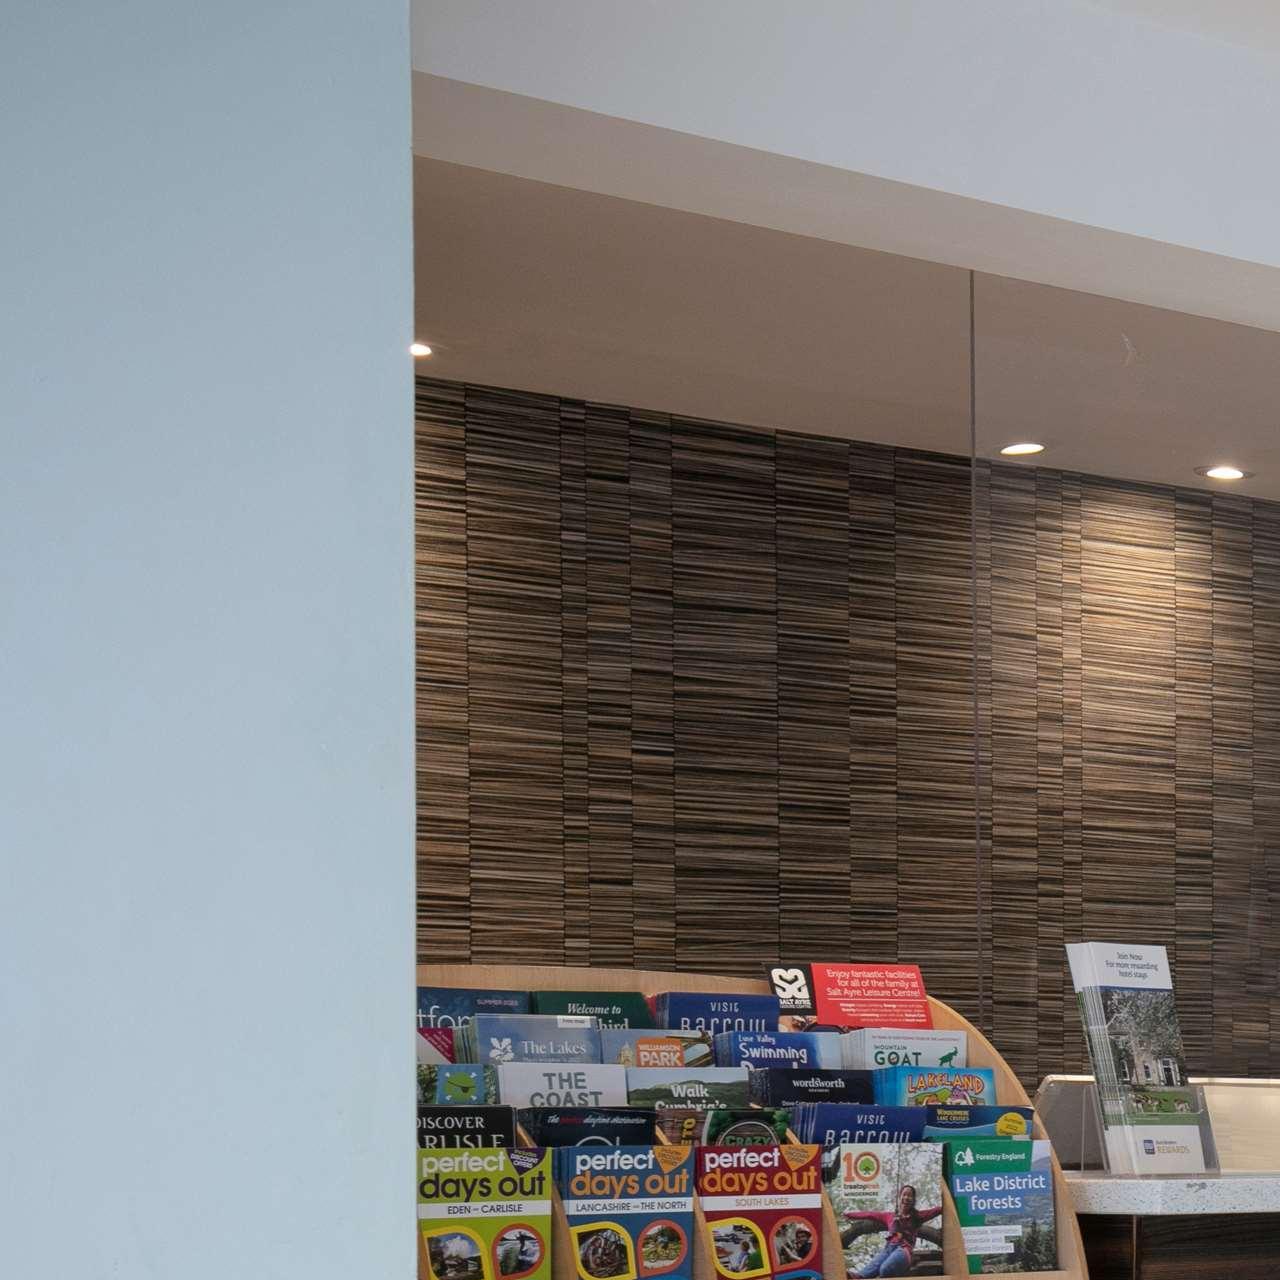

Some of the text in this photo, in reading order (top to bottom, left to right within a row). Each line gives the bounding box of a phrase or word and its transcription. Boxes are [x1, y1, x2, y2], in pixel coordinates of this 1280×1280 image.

[826, 968, 917, 979] Enjoy fantastic facilities
[837, 978, 850, 987] for
[851, 979, 860, 987] all
[861, 979, 870, 987] of
[871, 979, 884, 988] the
[885, 979, 910, 989] family
[826, 987, 842, 997] Salt
[843, 988, 862, 998] Ayre
[862, 988, 891, 998] Leisure
[567, 1002, 622, 1015] Welcome to
[521, 1040, 587, 1055] The Lakes
[756, 1034, 776, 1046] Valley
[639, 1051, 683, 1066] PARK
[738, 1042, 808, 1064] Swimming
[873, 1050, 922, 1067] GOAT
[542, 1071, 588, 1090] THE
[791, 1076, 846, 1089] wordsworth
[907, 1072, 985, 1096] LAKELAND
[529, 1091, 604, 1107] COAST
[670, 1083, 710, 1099] Walk
[655, 1100, 728, 1111] Cumbria's
[725, 1135, 772, 1146] CRAZY
[421, 1151, 506, 1178] perfect
[575, 1149, 655, 1175] perfect
[704, 1147, 781, 1173] perfect
[975, 1152, 1026, 1162] Forestry England
[842, 1151, 881, 1183] 10
[419, 1170, 546, 1203] days out
[570, 1168, 689, 1200] days out
[702, 1165, 818, 1197] days out
[955, 1174, 1047, 1193] Lake District
[447, 1205, 471, 1215] EDEN
[480, 1203, 524, 1214] CARLISLE
[575, 1202, 631, 1213] LANCASHIRE
[640, 1201, 656, 1210] THE
[656, 1201, 687, 1210] NORTH
[735, 1196, 790, 1208] SOUTH LAKES
[970, 1194, 1023, 1211] forests
